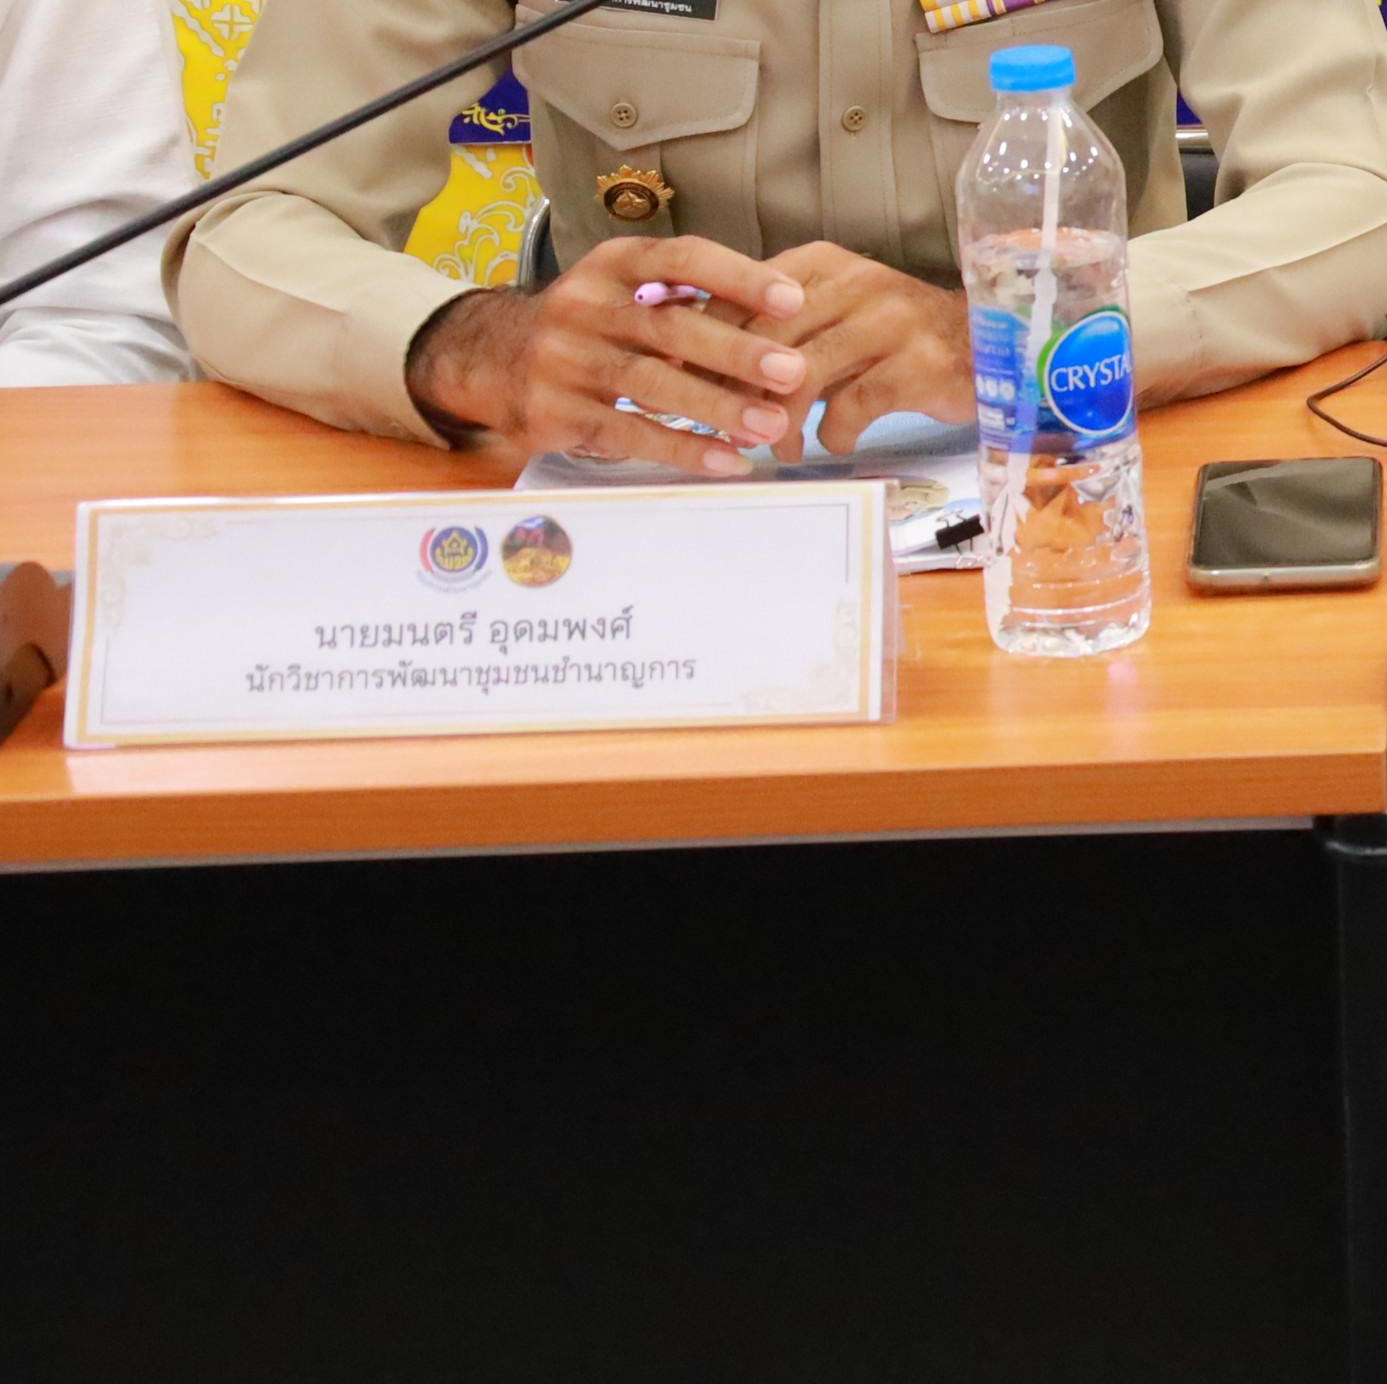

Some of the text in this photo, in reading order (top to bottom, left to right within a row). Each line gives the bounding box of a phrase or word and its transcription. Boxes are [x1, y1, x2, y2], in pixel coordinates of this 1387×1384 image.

[314, 604, 634, 656] นายมนตรี อุดมพงศ์
[245, 655, 697, 695] นักวิชาการพัฒนาชุมชนชำนาญการ
